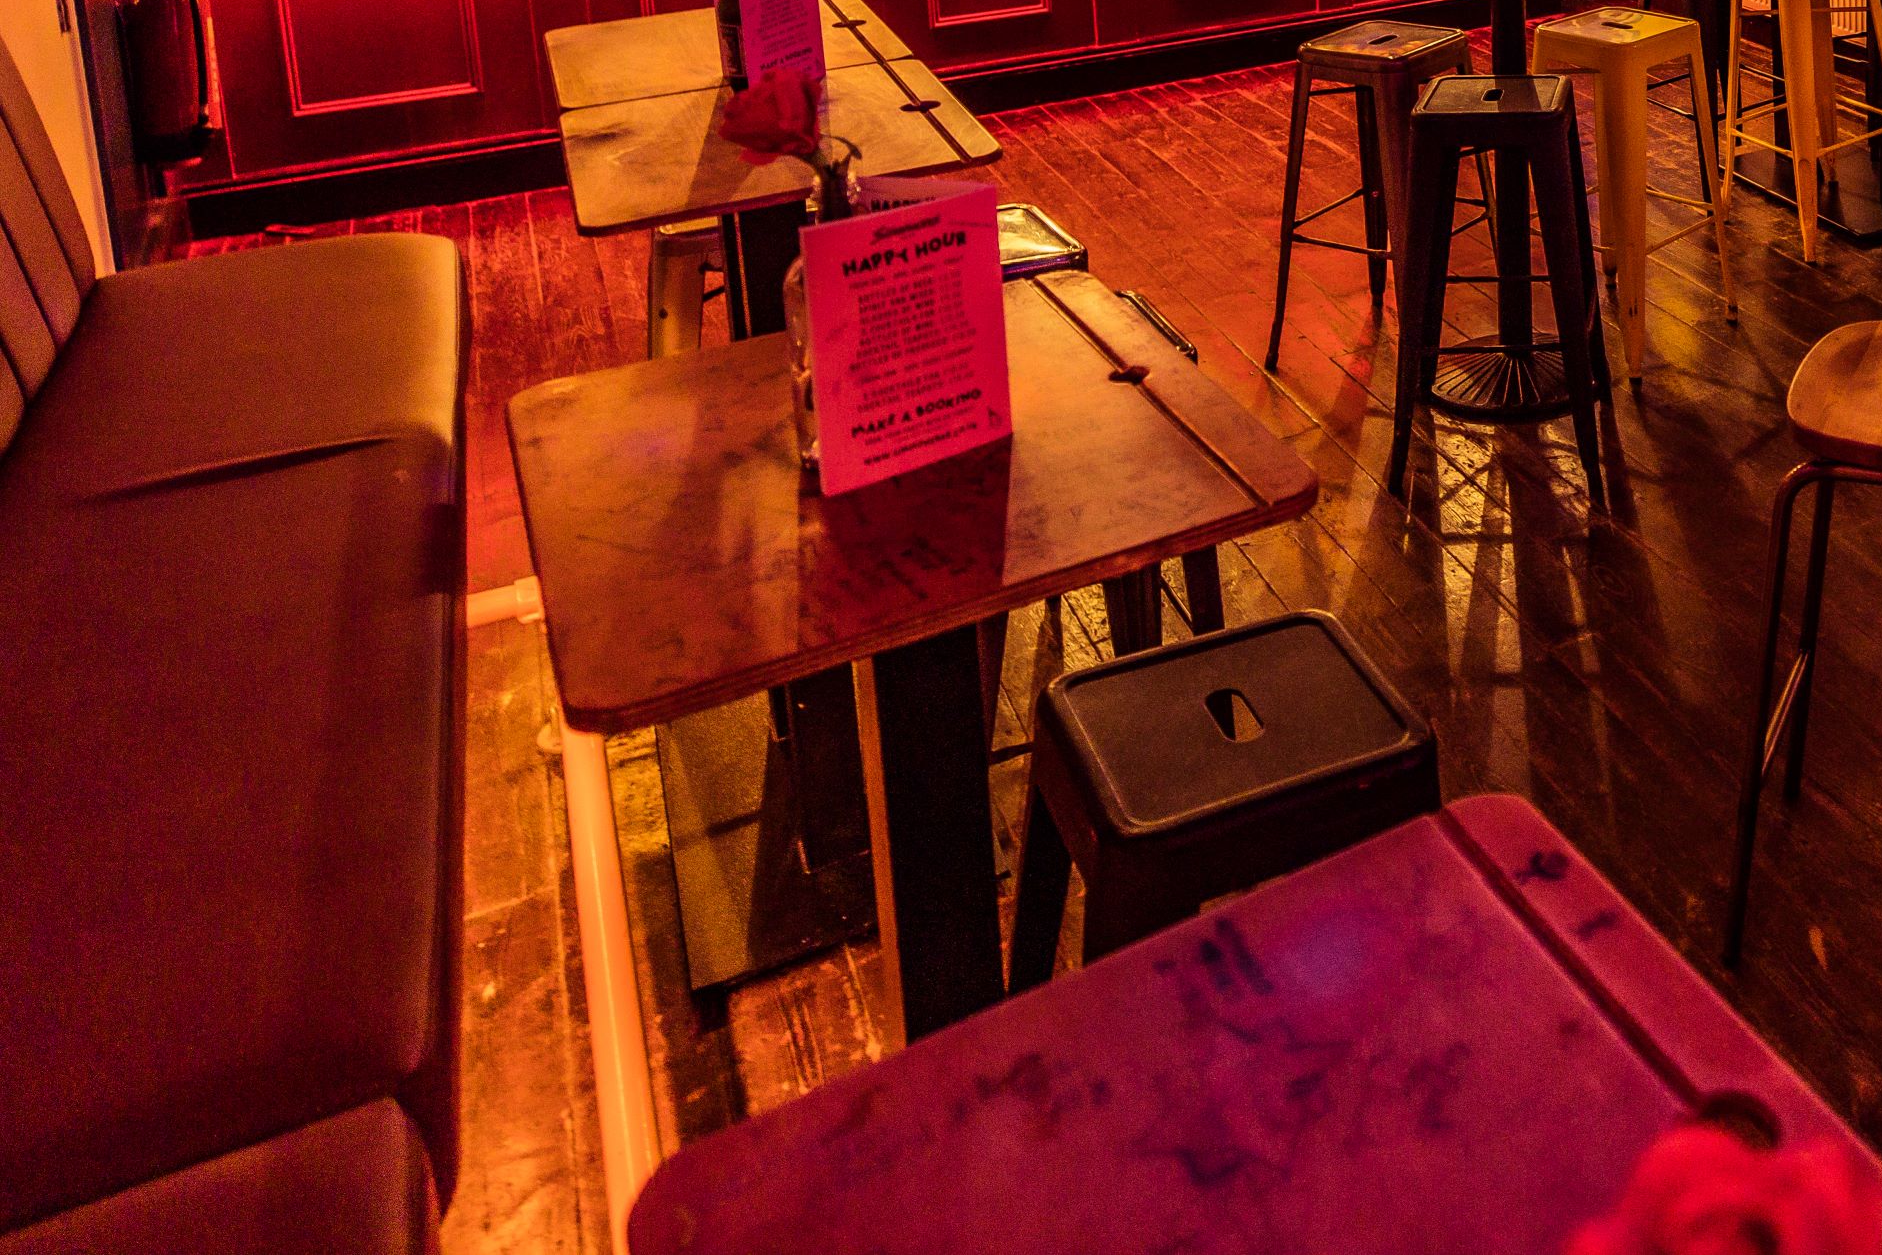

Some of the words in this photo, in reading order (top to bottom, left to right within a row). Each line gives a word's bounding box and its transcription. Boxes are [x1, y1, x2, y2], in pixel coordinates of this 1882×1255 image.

[842, 248, 909, 277] HAPPY
[915, 230, 967, 258] HOUR
[851, 413, 896, 439] MAKE
[901, 411, 911, 423] A
[916, 388, 983, 417] BOOKING
